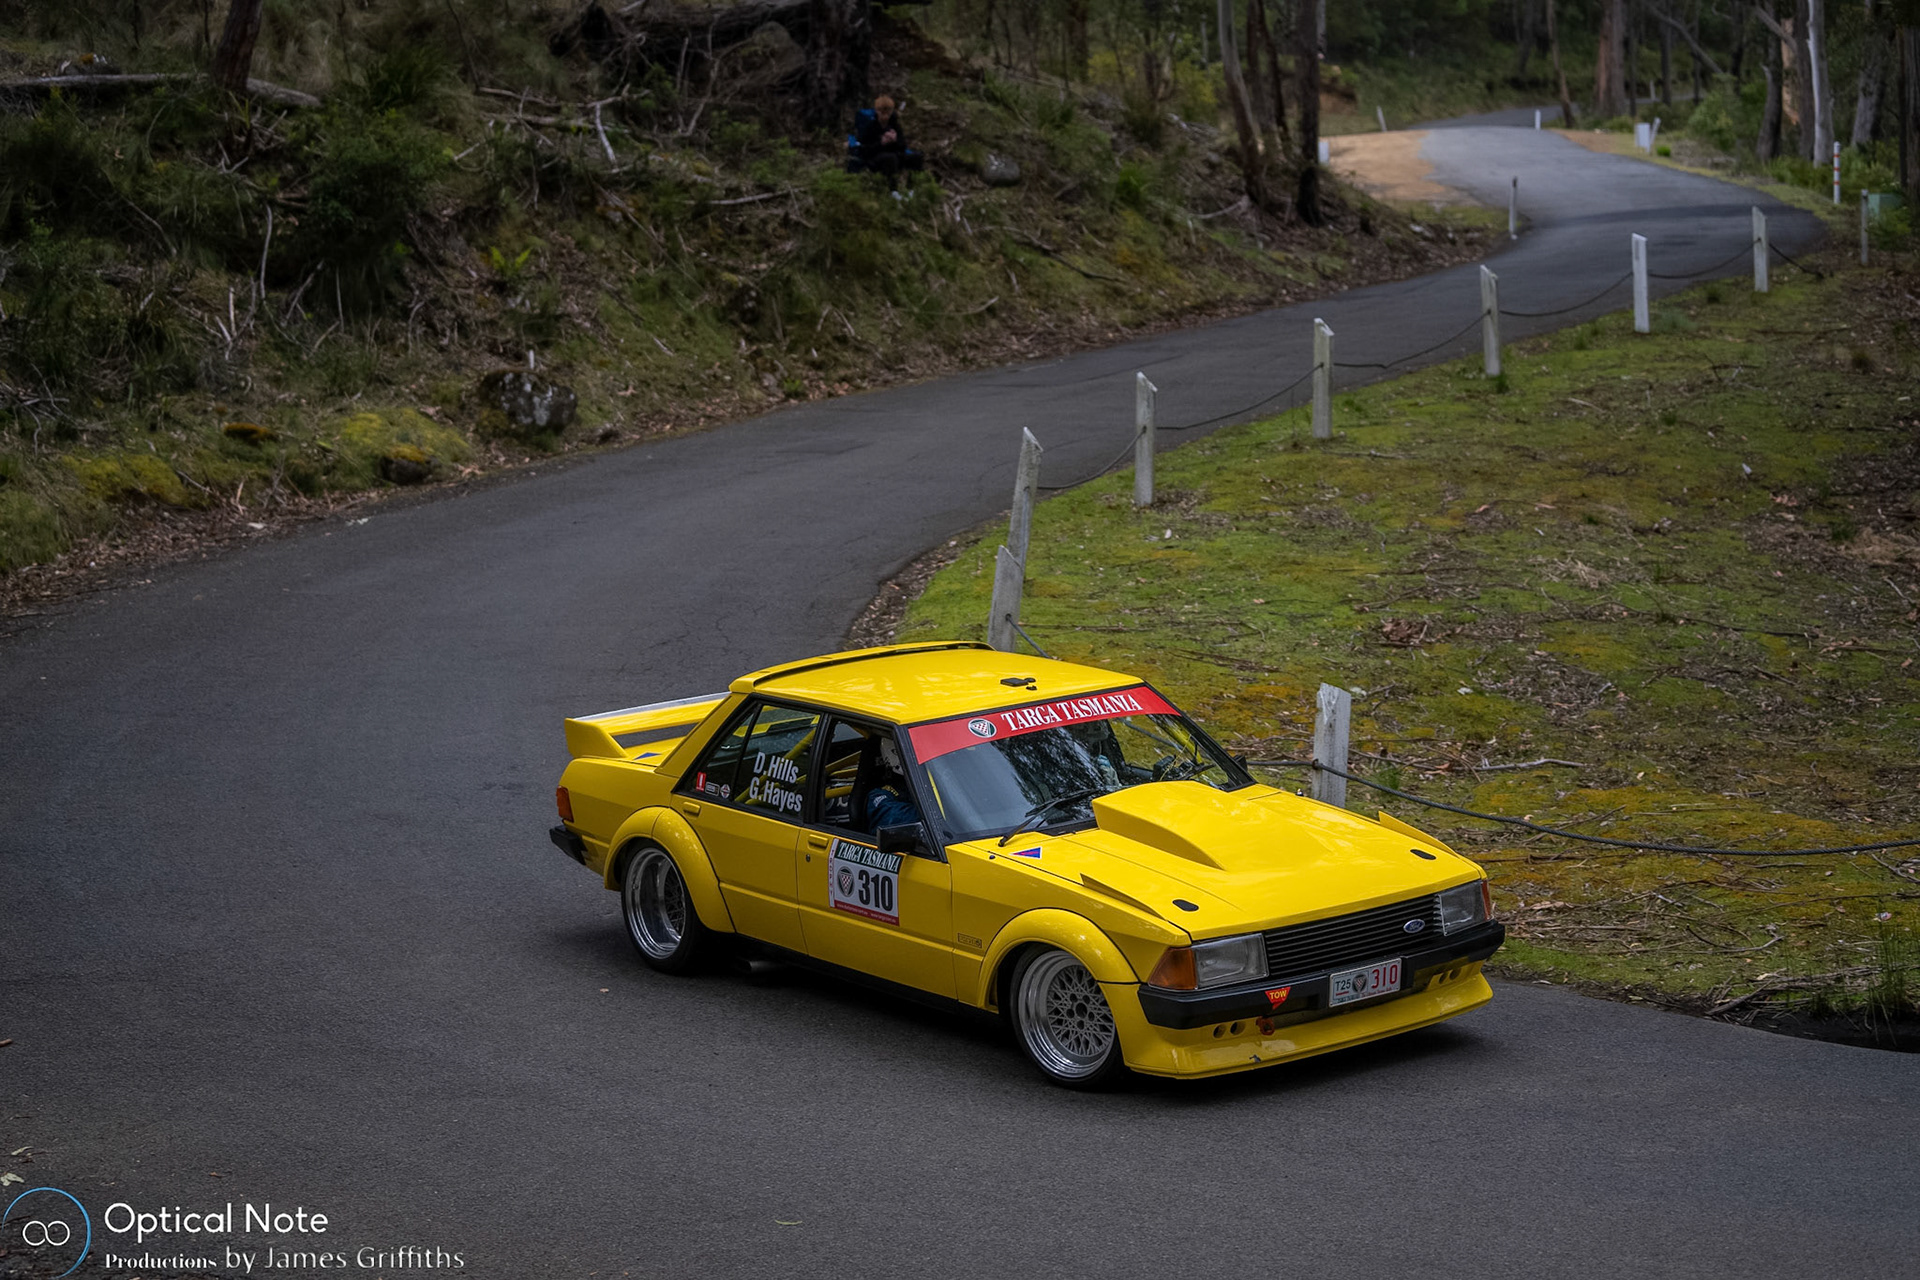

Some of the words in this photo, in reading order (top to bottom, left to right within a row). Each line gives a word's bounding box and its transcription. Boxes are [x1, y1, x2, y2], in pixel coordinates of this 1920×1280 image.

[1001, 704, 1061, 731] TARGA
[1057, 693, 1143, 721] TASMANIA
[837, 842, 864, 863] TARGA
[861, 848, 901, 873] TASMANIA
[858, 869, 893, 912] 310
[1335, 978, 1351, 992] T25
[1371, 964, 1398, 989] 310
[1269, 989, 1287, 1000] TOW
